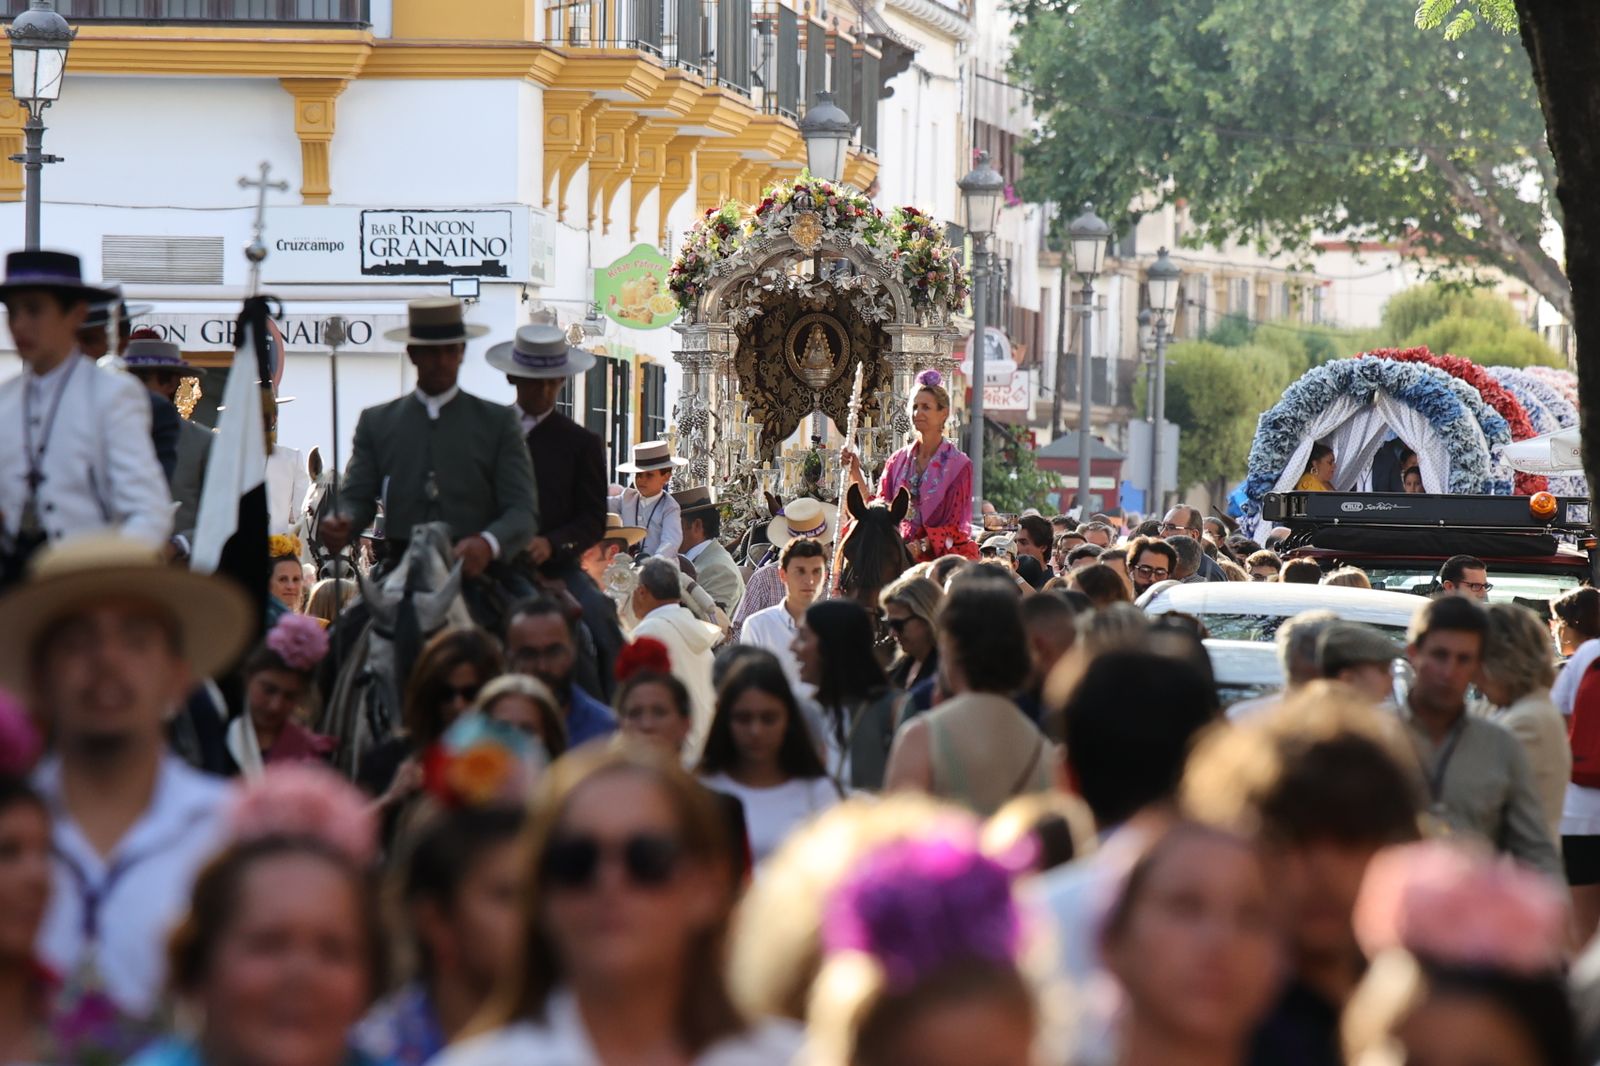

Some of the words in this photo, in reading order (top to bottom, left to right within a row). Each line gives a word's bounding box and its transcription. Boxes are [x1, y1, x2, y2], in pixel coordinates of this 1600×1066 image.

[371, 223, 397, 235] BAR
[276, 239, 345, 253] Cruzcampo
[370, 237, 507, 257] GRANAINO
